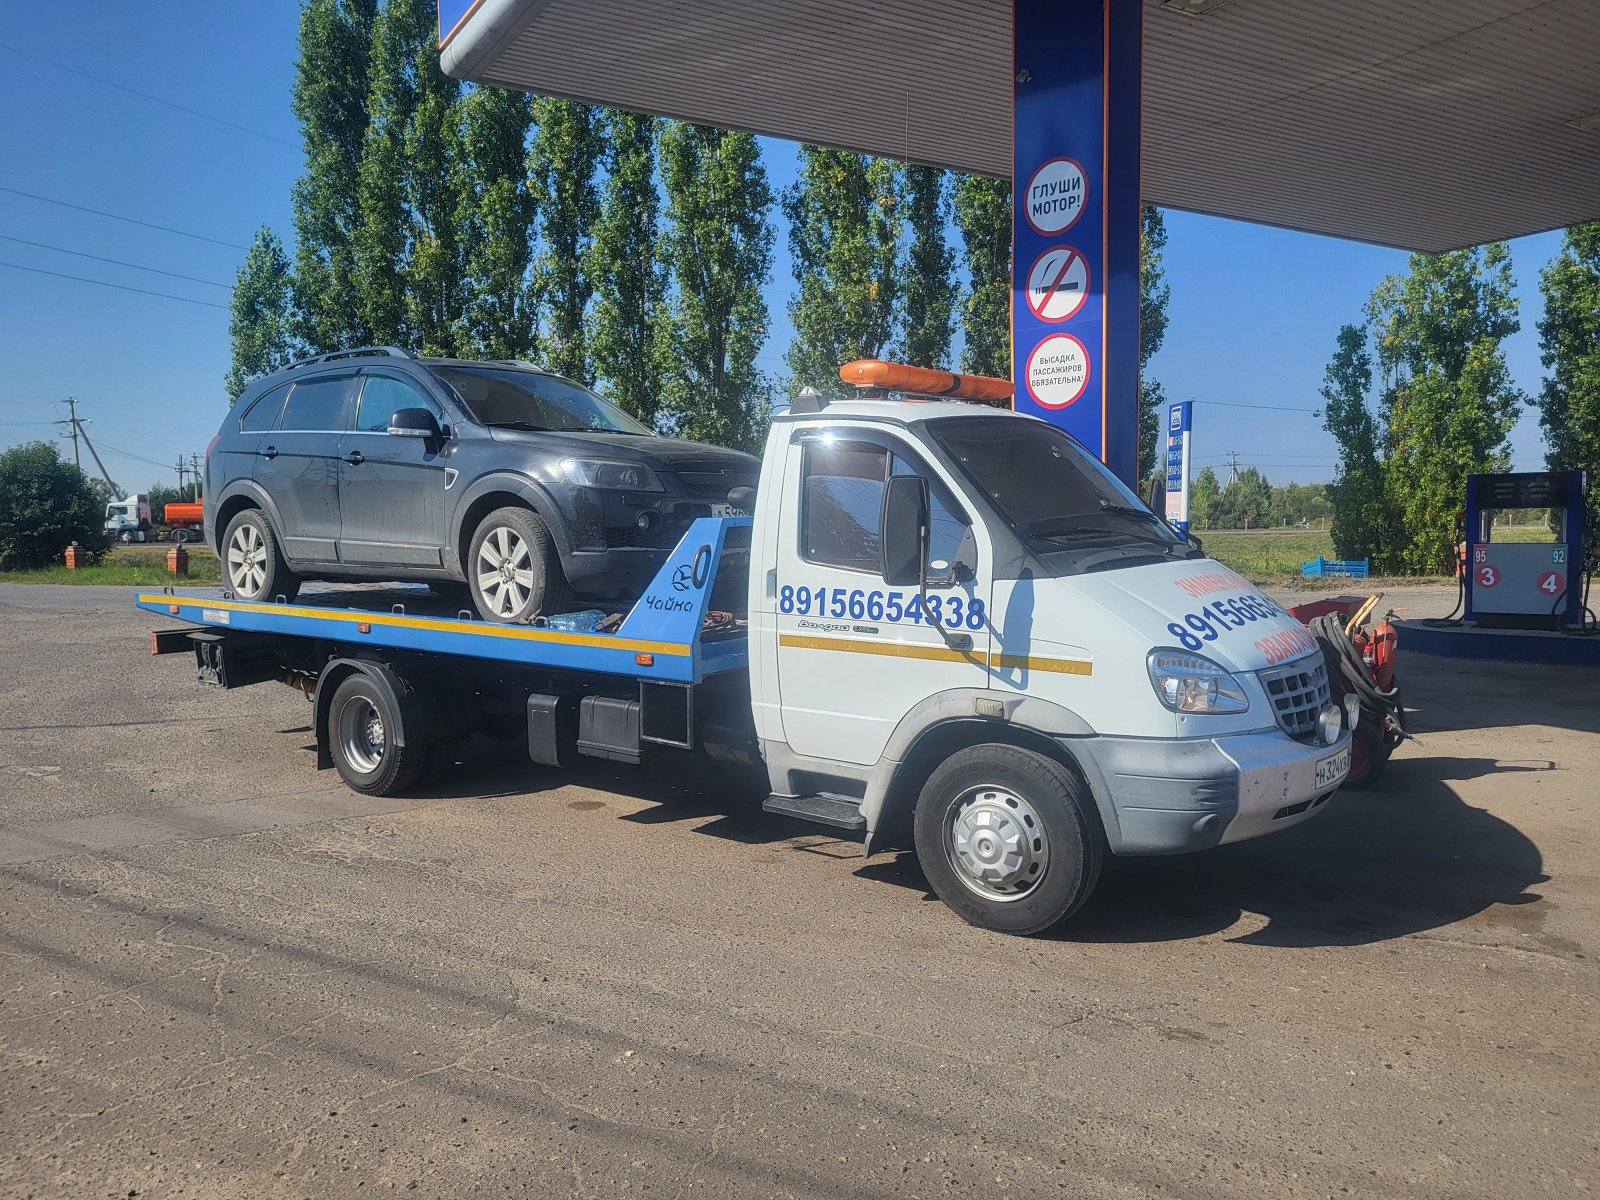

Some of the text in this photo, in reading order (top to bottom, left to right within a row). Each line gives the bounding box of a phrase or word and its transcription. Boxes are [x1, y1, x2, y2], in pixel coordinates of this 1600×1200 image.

[1032, 176, 1081, 200] ГЛУШИ
[1032, 194, 1081, 217] МОТОР!
[1039, 353, 1075, 365] ВЫСАДКА
[1032, 364, 1082, 376] ПАССАЖИРОВ
[1031, 374, 1084, 387] ОБЯЗАТЕЛЬНА!
[1475, 550, 1487, 563] 95
[1553, 550, 1565, 563] 92
[1481, 567, 1495, 586] 3
[1542, 574, 1557, 593] 4
[646, 594, 694, 613] Чайка
[779, 584, 986, 630] 89156654338
